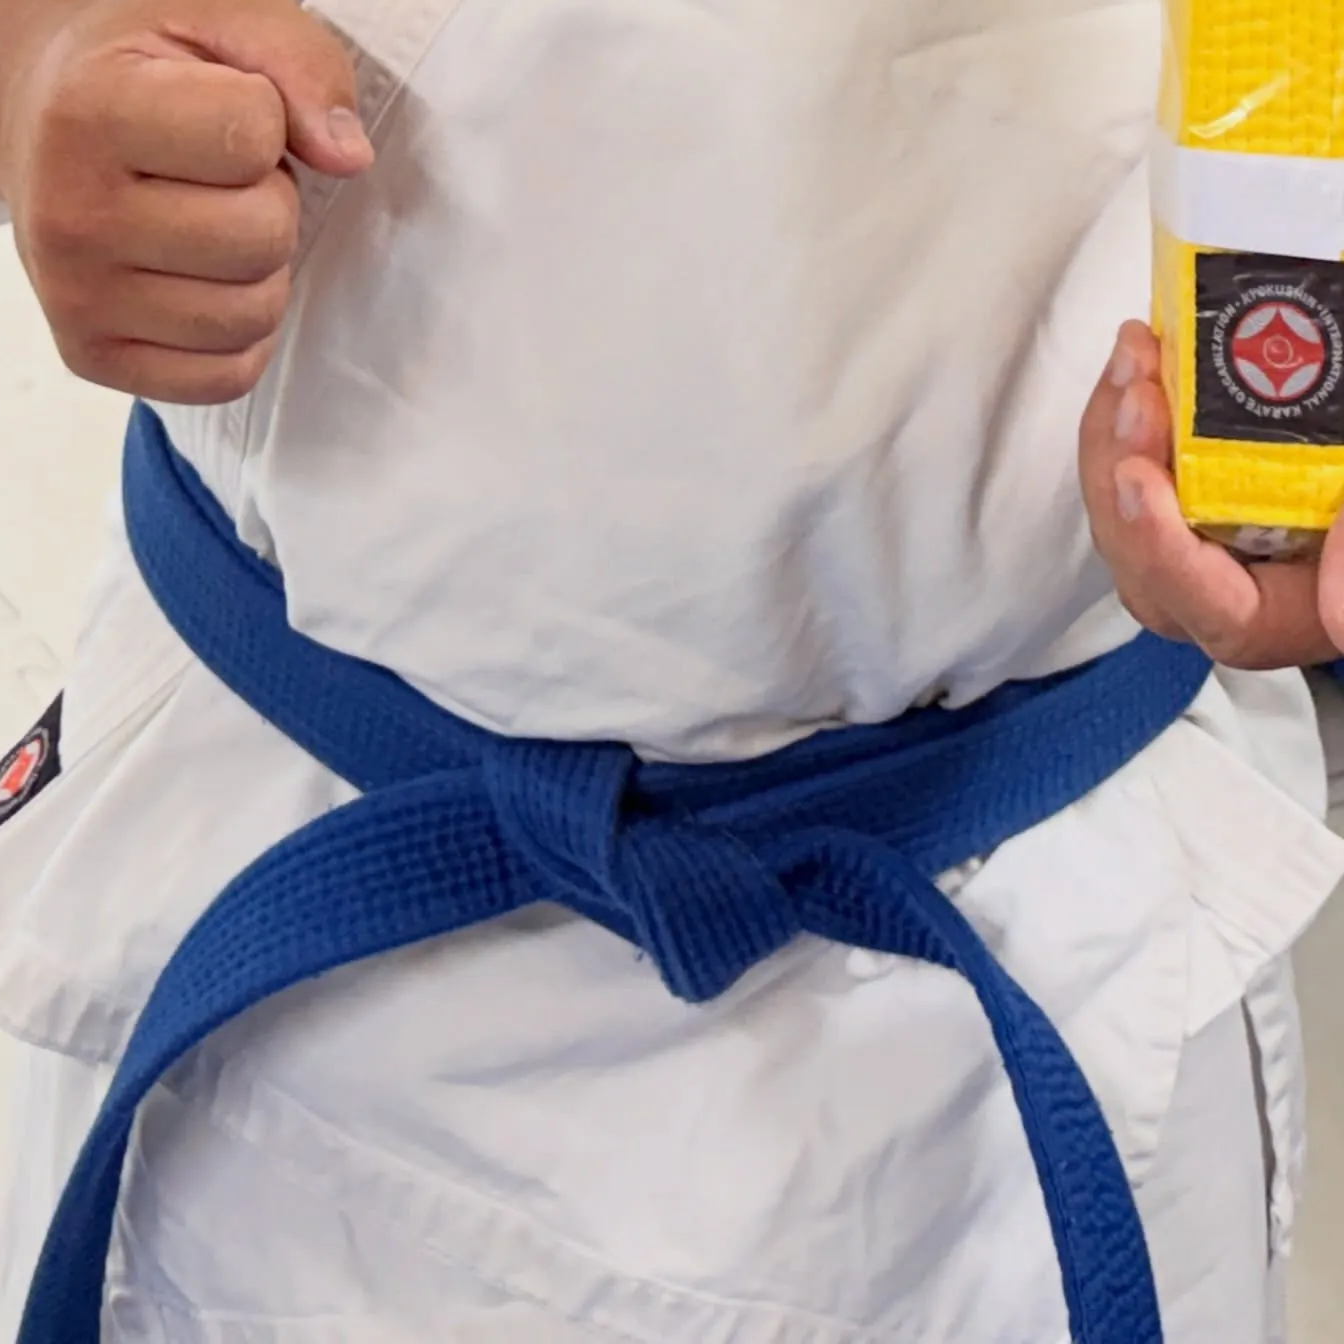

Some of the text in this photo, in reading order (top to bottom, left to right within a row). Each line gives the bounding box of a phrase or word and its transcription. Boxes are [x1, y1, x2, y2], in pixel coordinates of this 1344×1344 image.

[1211, 284, 1344, 419] KYOKUSHIN INTERNATIONAL KARATE ORGANIZATION
